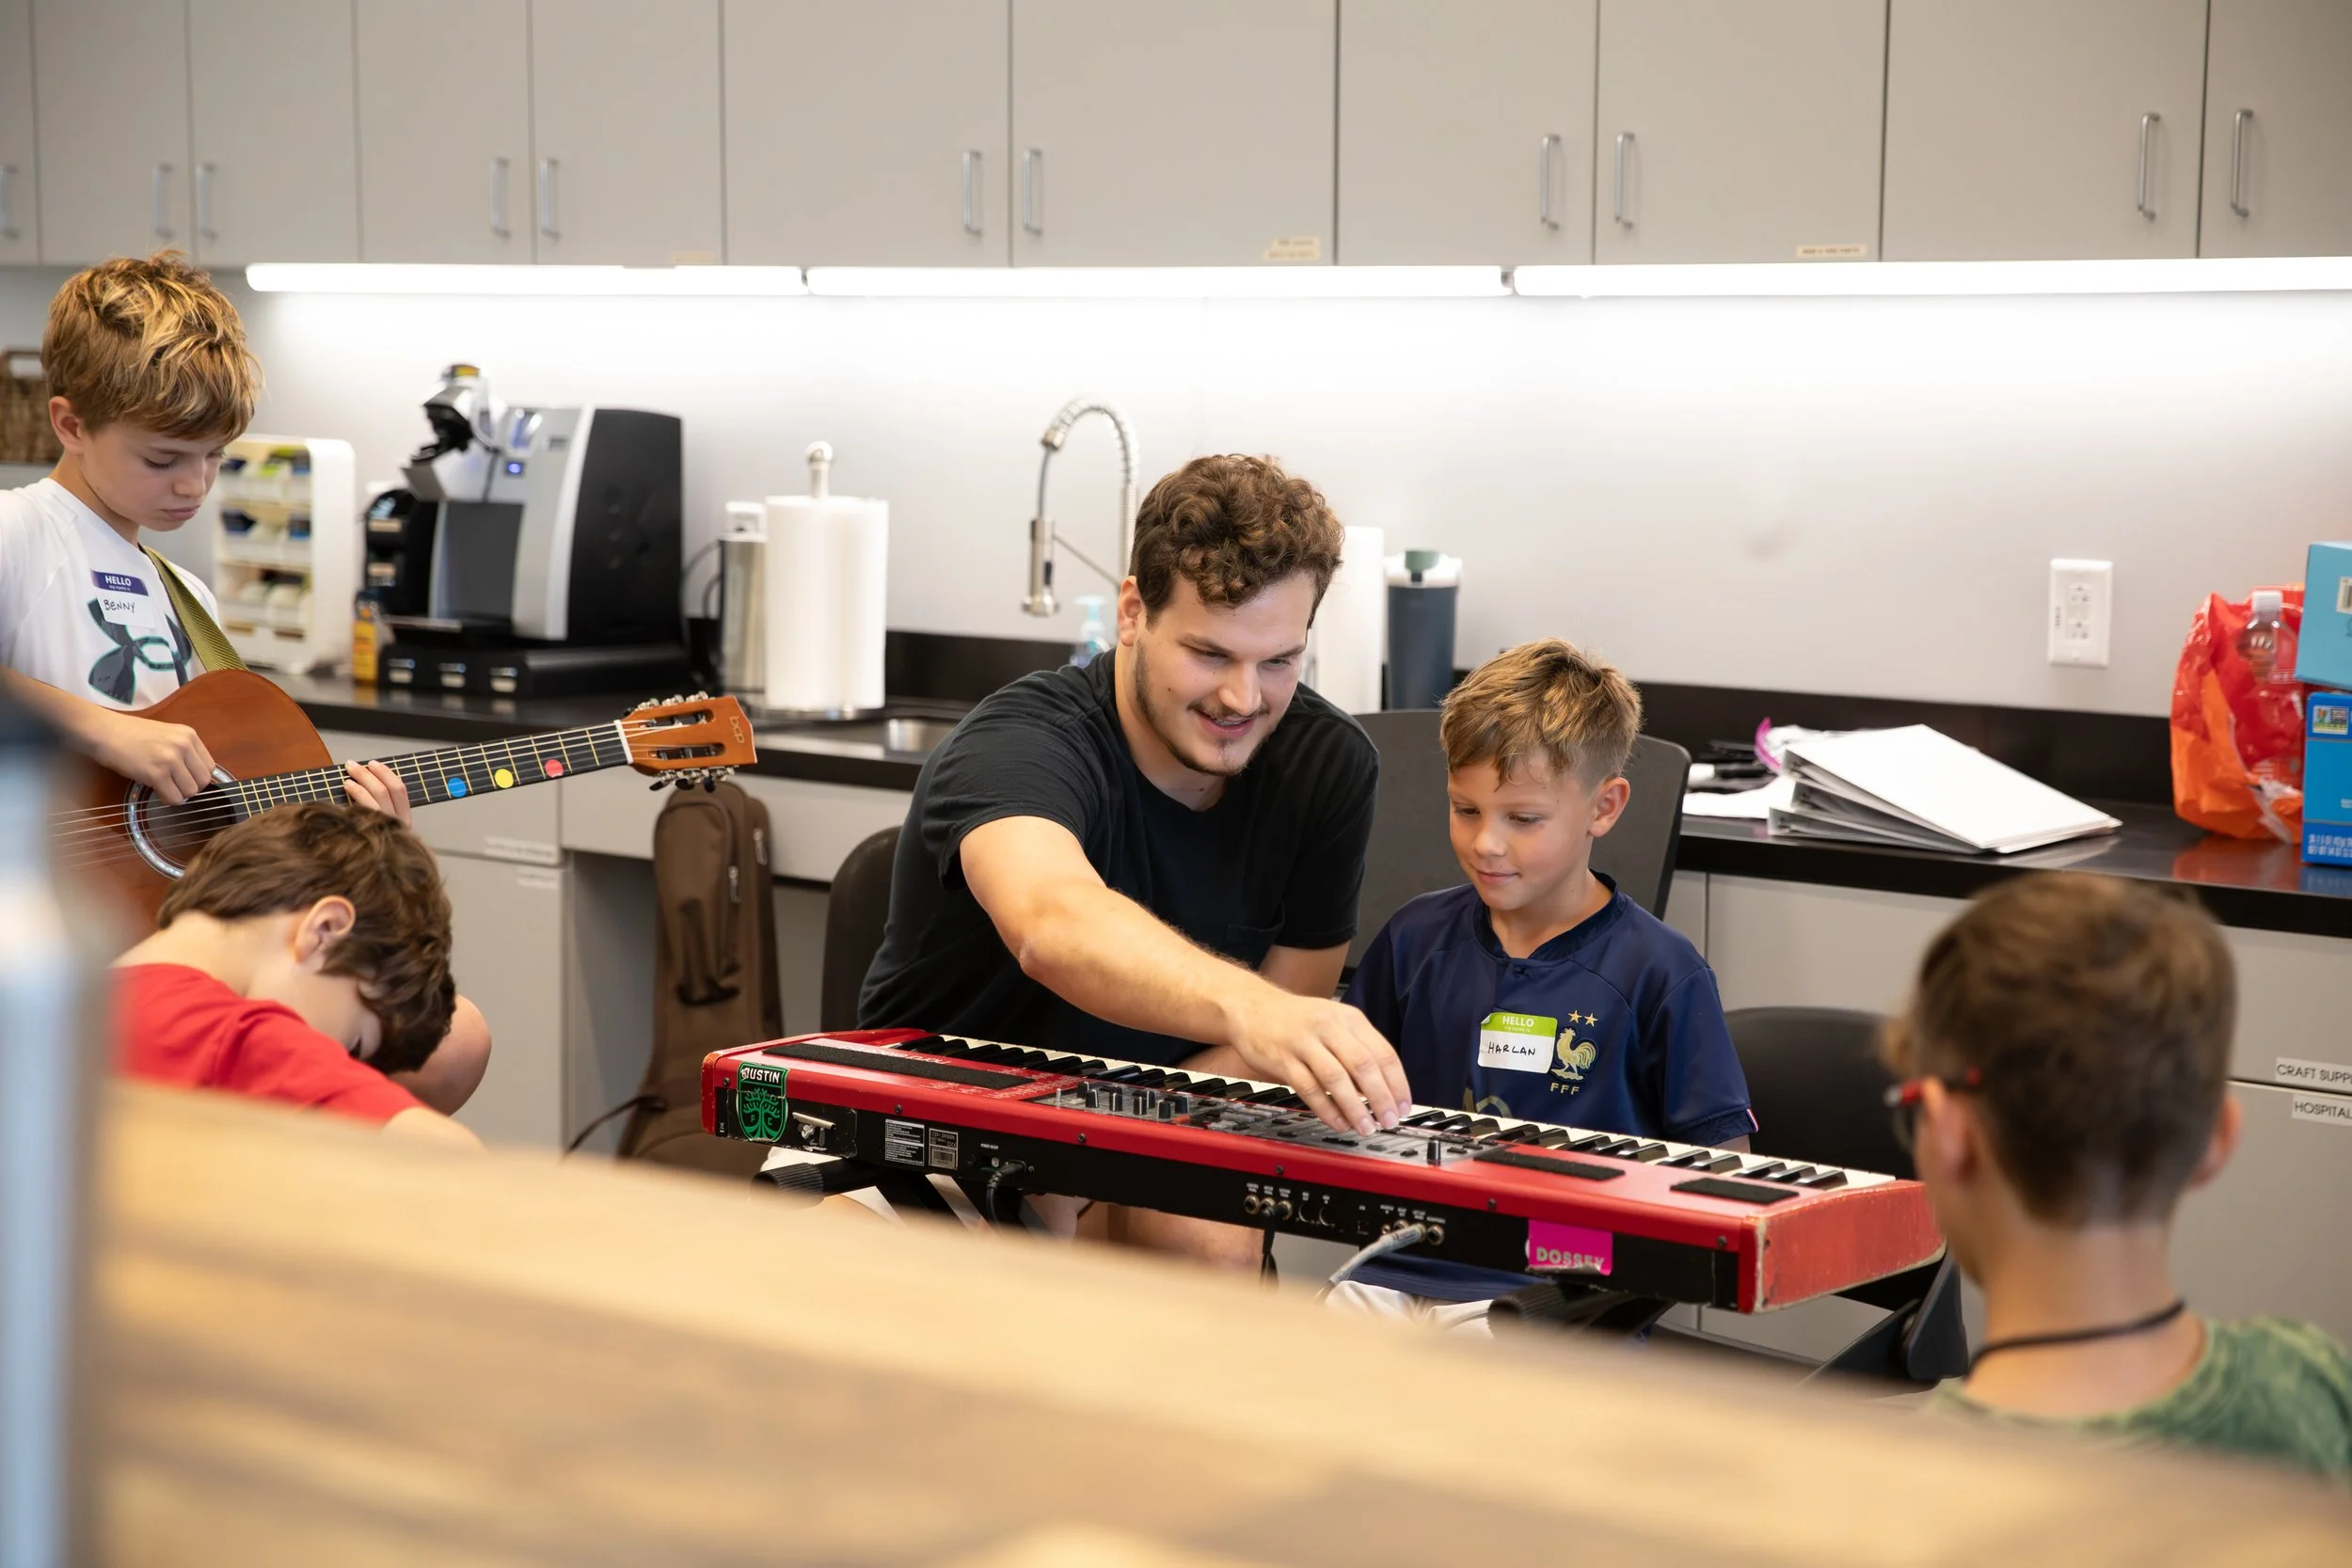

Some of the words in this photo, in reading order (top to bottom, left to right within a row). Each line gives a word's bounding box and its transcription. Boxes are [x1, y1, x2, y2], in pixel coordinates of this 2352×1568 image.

[105, 576, 132, 587] HELLO
[103, 599, 135, 613] BENNY
[1502, 1016, 1534, 1027] HELLO
[1488, 1041, 1535, 1055] HARLAN
[2277, 1064, 2315, 1079] CRAFT
[1550, 1082, 1580, 1095] FFF
[2295, 1101, 2352, 1120] HOSPITAL
